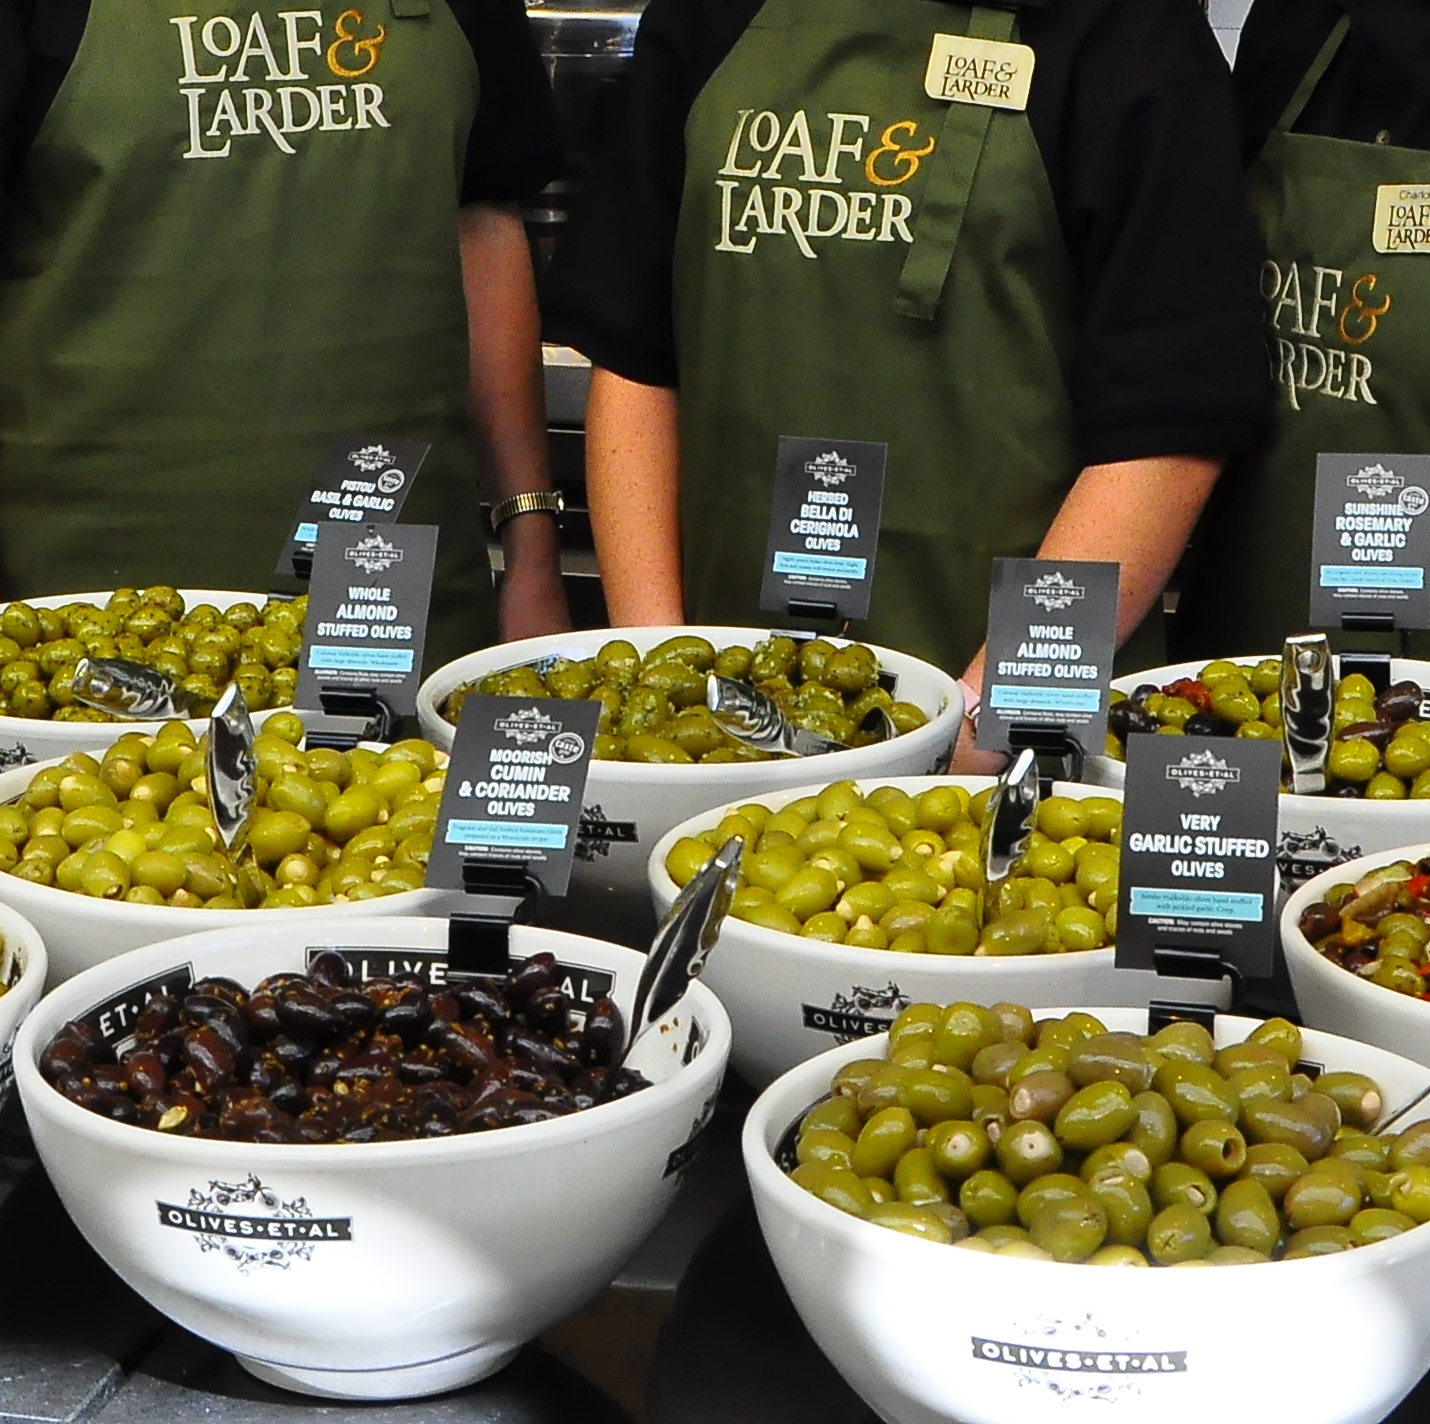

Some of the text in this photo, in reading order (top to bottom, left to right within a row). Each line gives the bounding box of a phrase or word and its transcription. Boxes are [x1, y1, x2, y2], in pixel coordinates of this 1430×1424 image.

[169, 11, 322, 84] LOAF
[179, 83, 391, 159] LARDER
[718, 108, 870, 184] LOAF
[715, 180, 914, 259] LARDER
[1388, 204, 1430, 227] LOAF
[1260, 260, 1342, 338] OAF
[1277, 338, 1377, 411] RDER
[1345, 502, 1404, 515] SUNSHINE
[1336, 516, 1413, 531] ROSEMARY
[1341, 532, 1406, 547] & GARLIC
[1352, 548, 1393, 561] OLIVES
[349, 586, 391, 601] WHOLE
[337, 603, 398, 620] ALMOND
[317, 622, 412, 639] STUFFED OLIVES
[490, 749, 552, 765] MOORISH
[491, 764, 546, 781] CUMIN
[459, 780, 570, 801] & CORIANDER
[487, 800, 535, 816] OLIVES
[1180, 813, 1221, 830] VERY
[1130, 832, 1269, 858] GARLIC STUFFED
[1172, 860, 1224, 878] OLIVES
